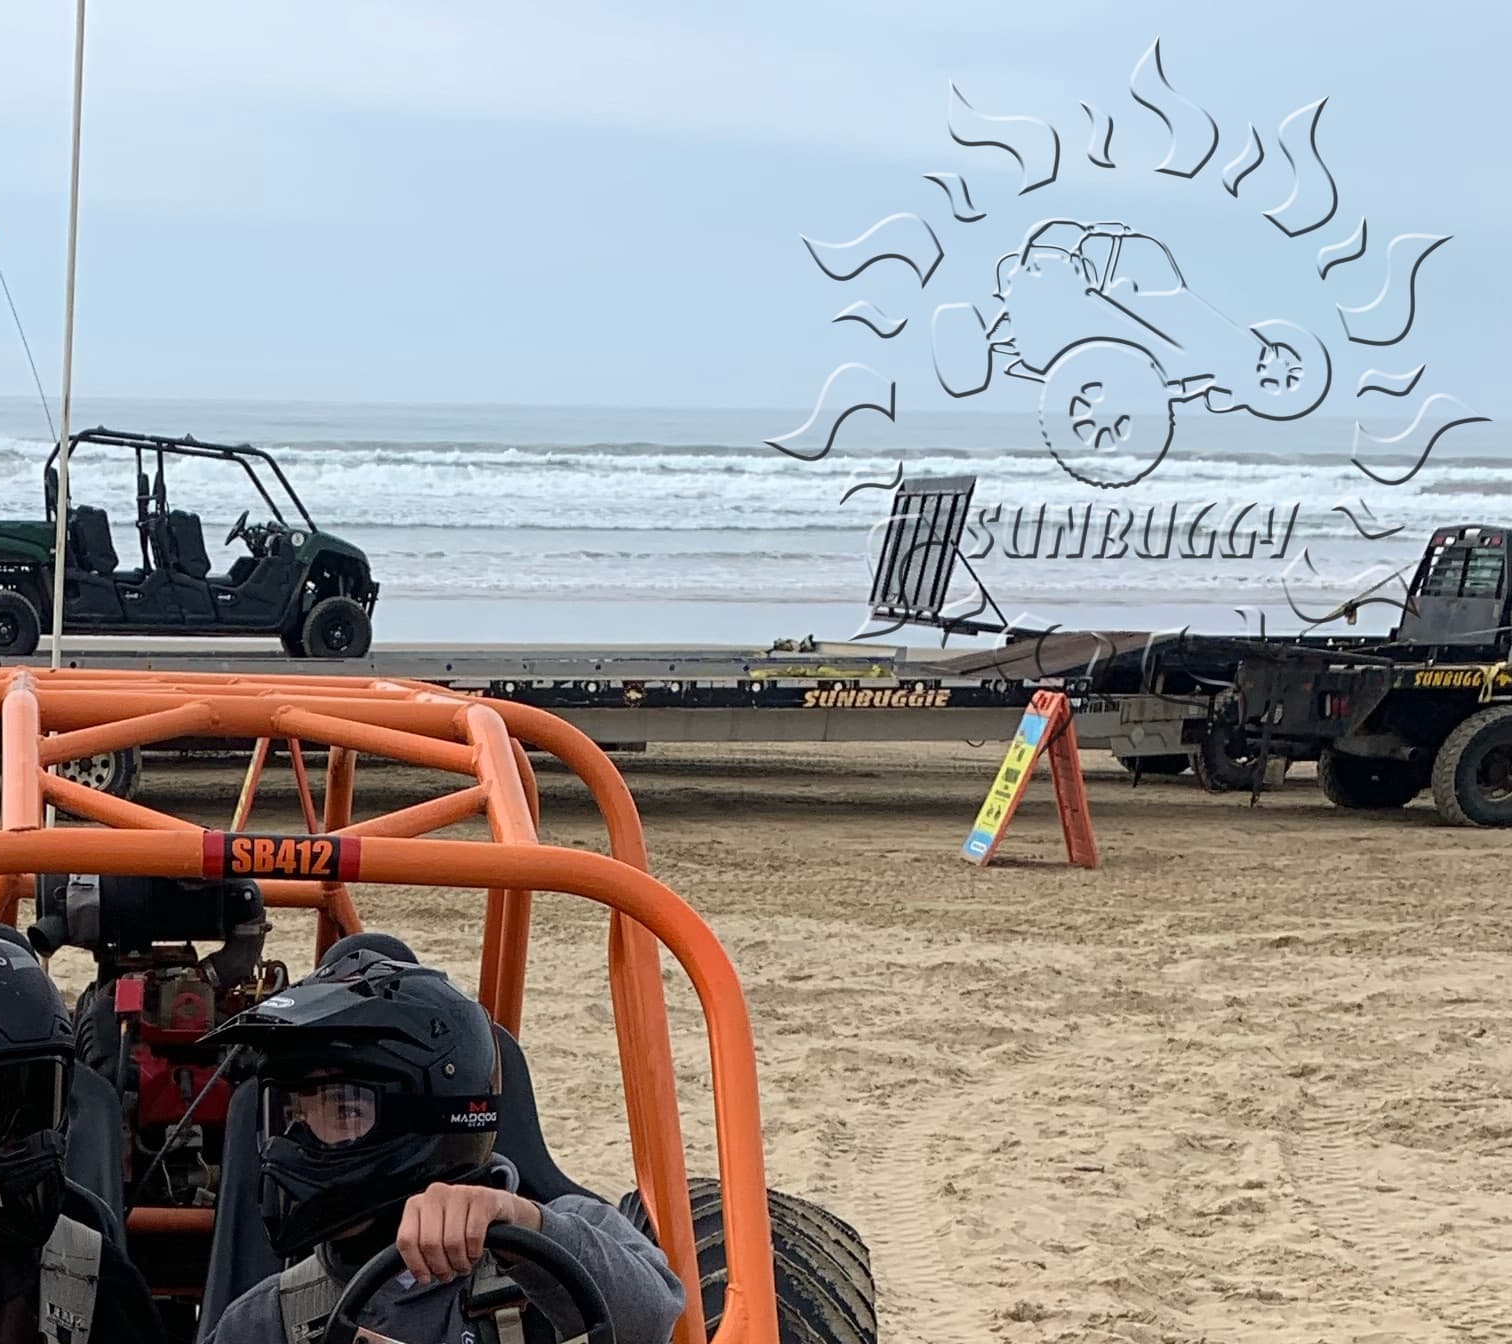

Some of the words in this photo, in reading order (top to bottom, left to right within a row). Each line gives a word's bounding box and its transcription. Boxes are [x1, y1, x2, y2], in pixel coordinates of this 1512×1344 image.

[1414, 671, 1484, 687] SUNBUGG
[802, 689, 951, 708] SUNBUGGIE
[231, 837, 334, 875] SB412
